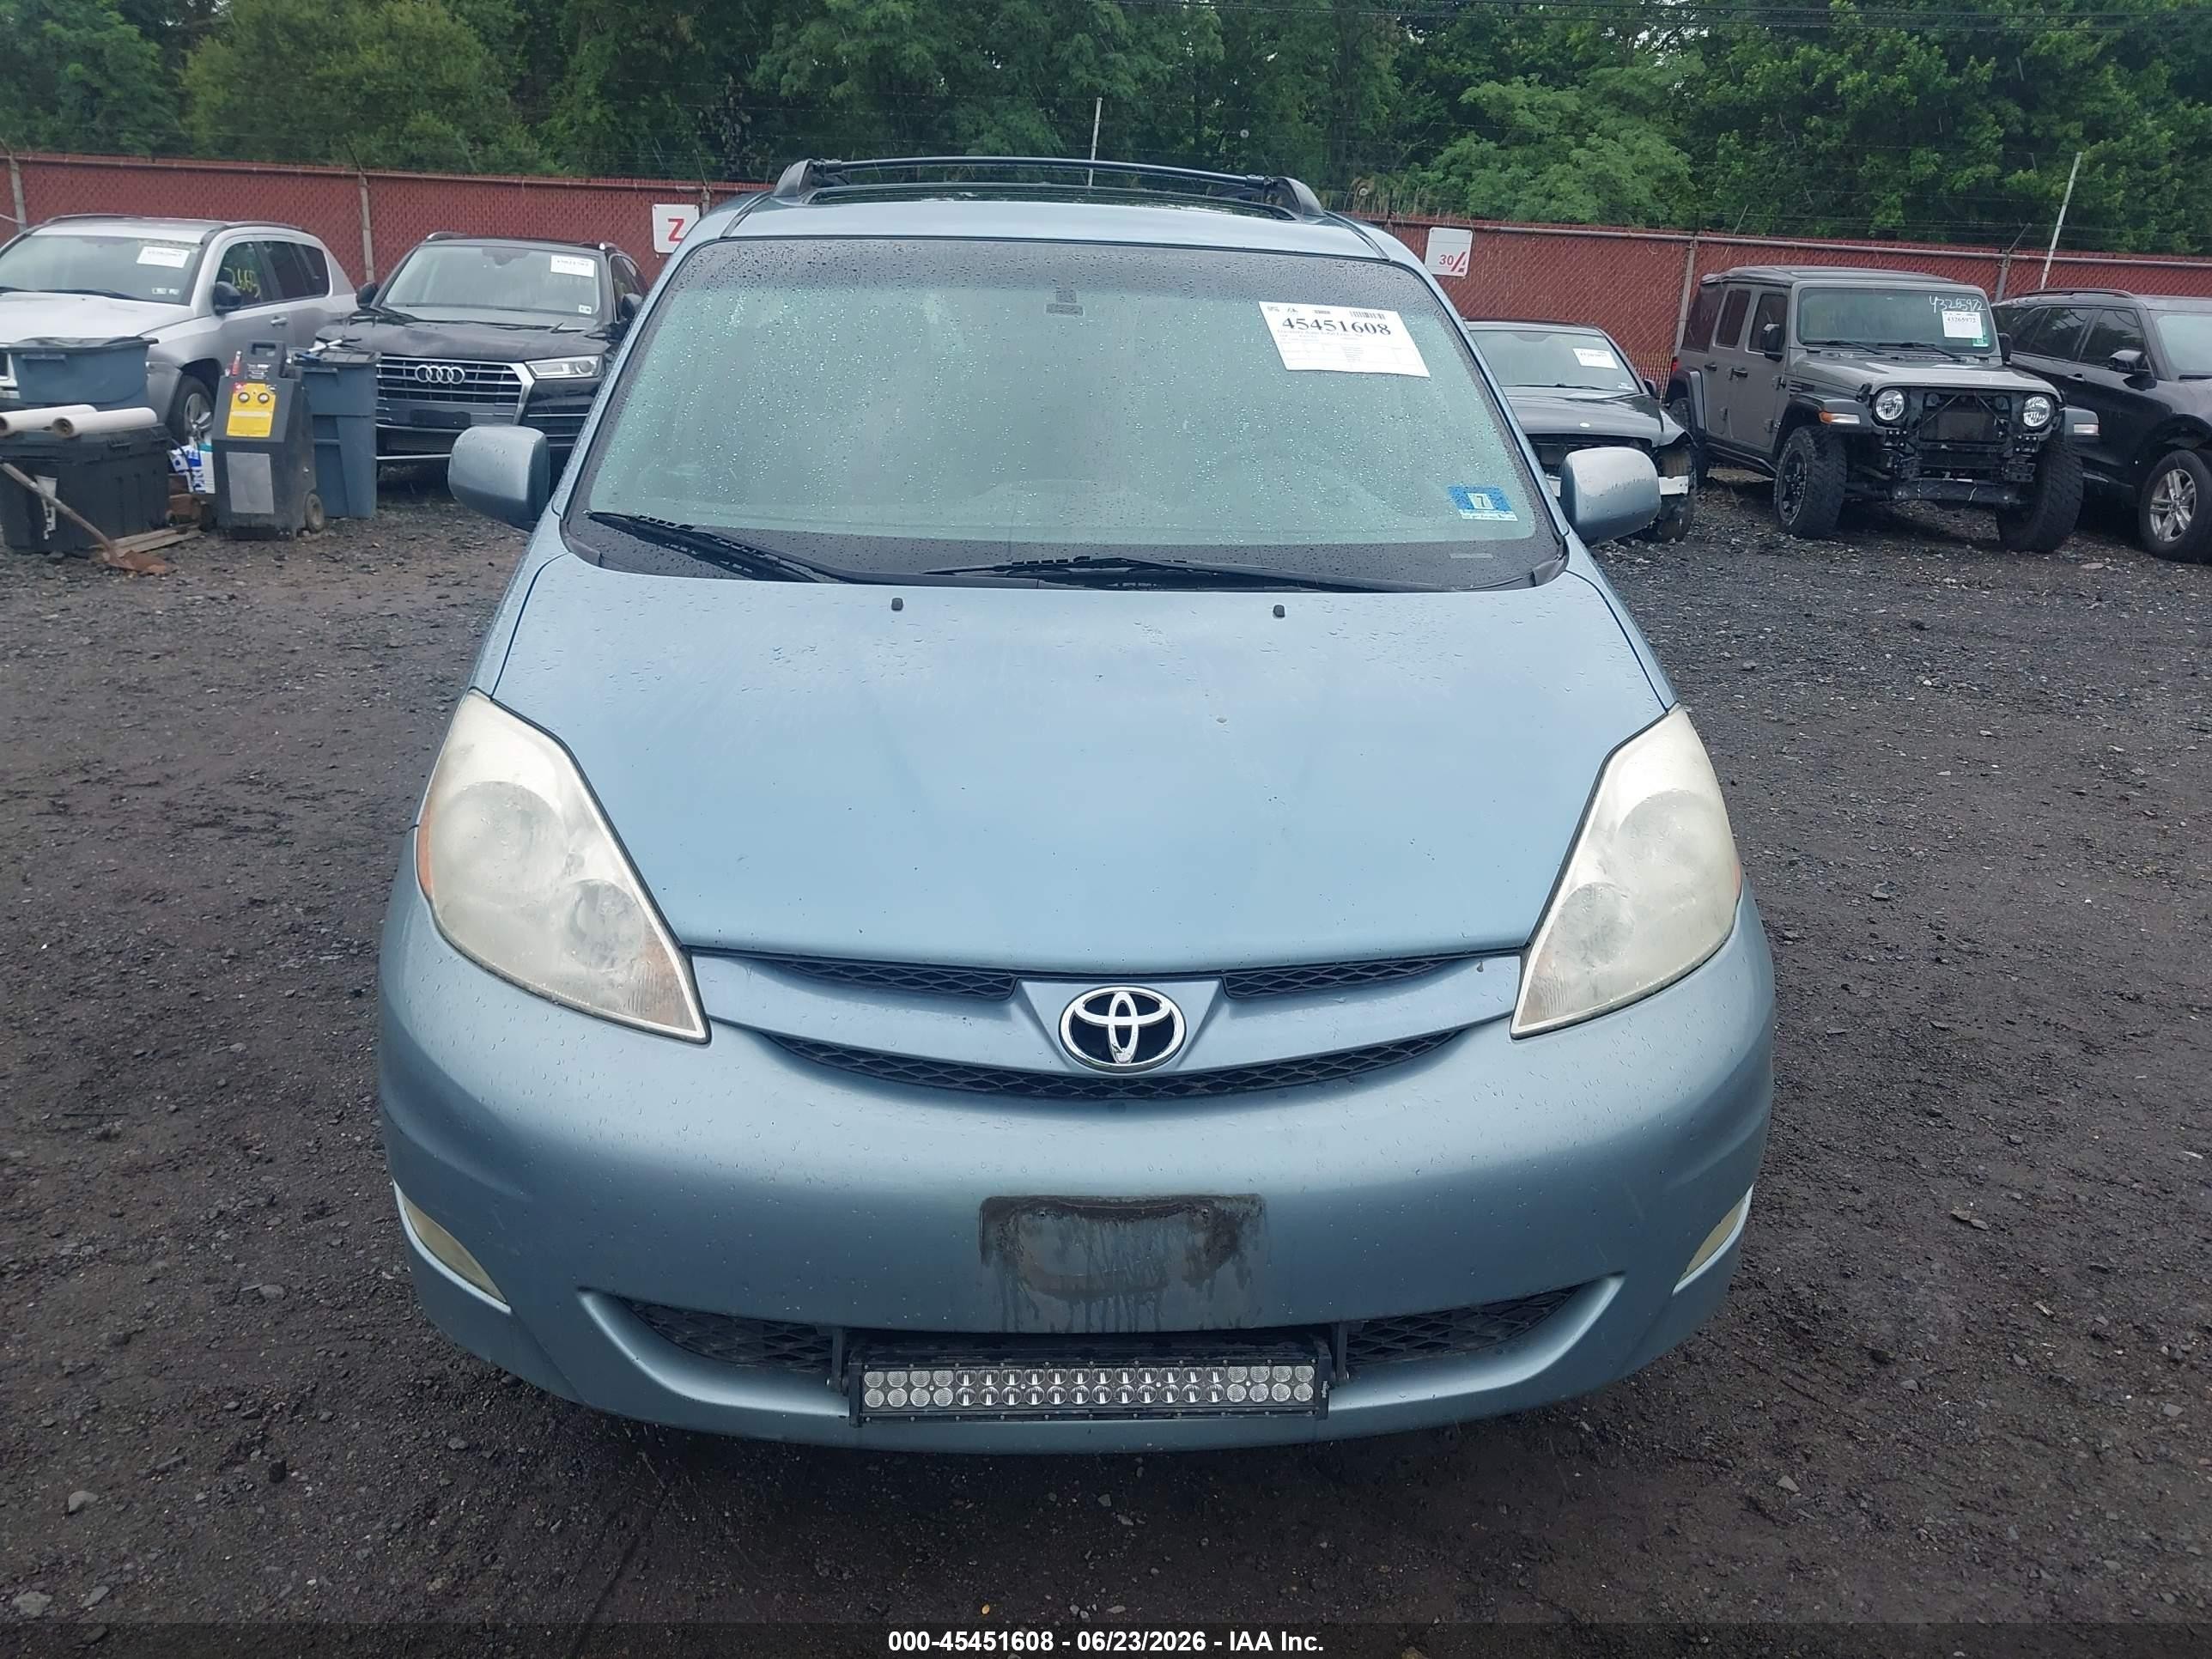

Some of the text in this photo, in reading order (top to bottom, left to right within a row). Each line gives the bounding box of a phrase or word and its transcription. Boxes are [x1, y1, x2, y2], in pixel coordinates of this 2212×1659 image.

[667, 218, 684, 242] Z
[1282, 317, 1392, 336] 45451608
[1476, 495, 1486, 507] 7
